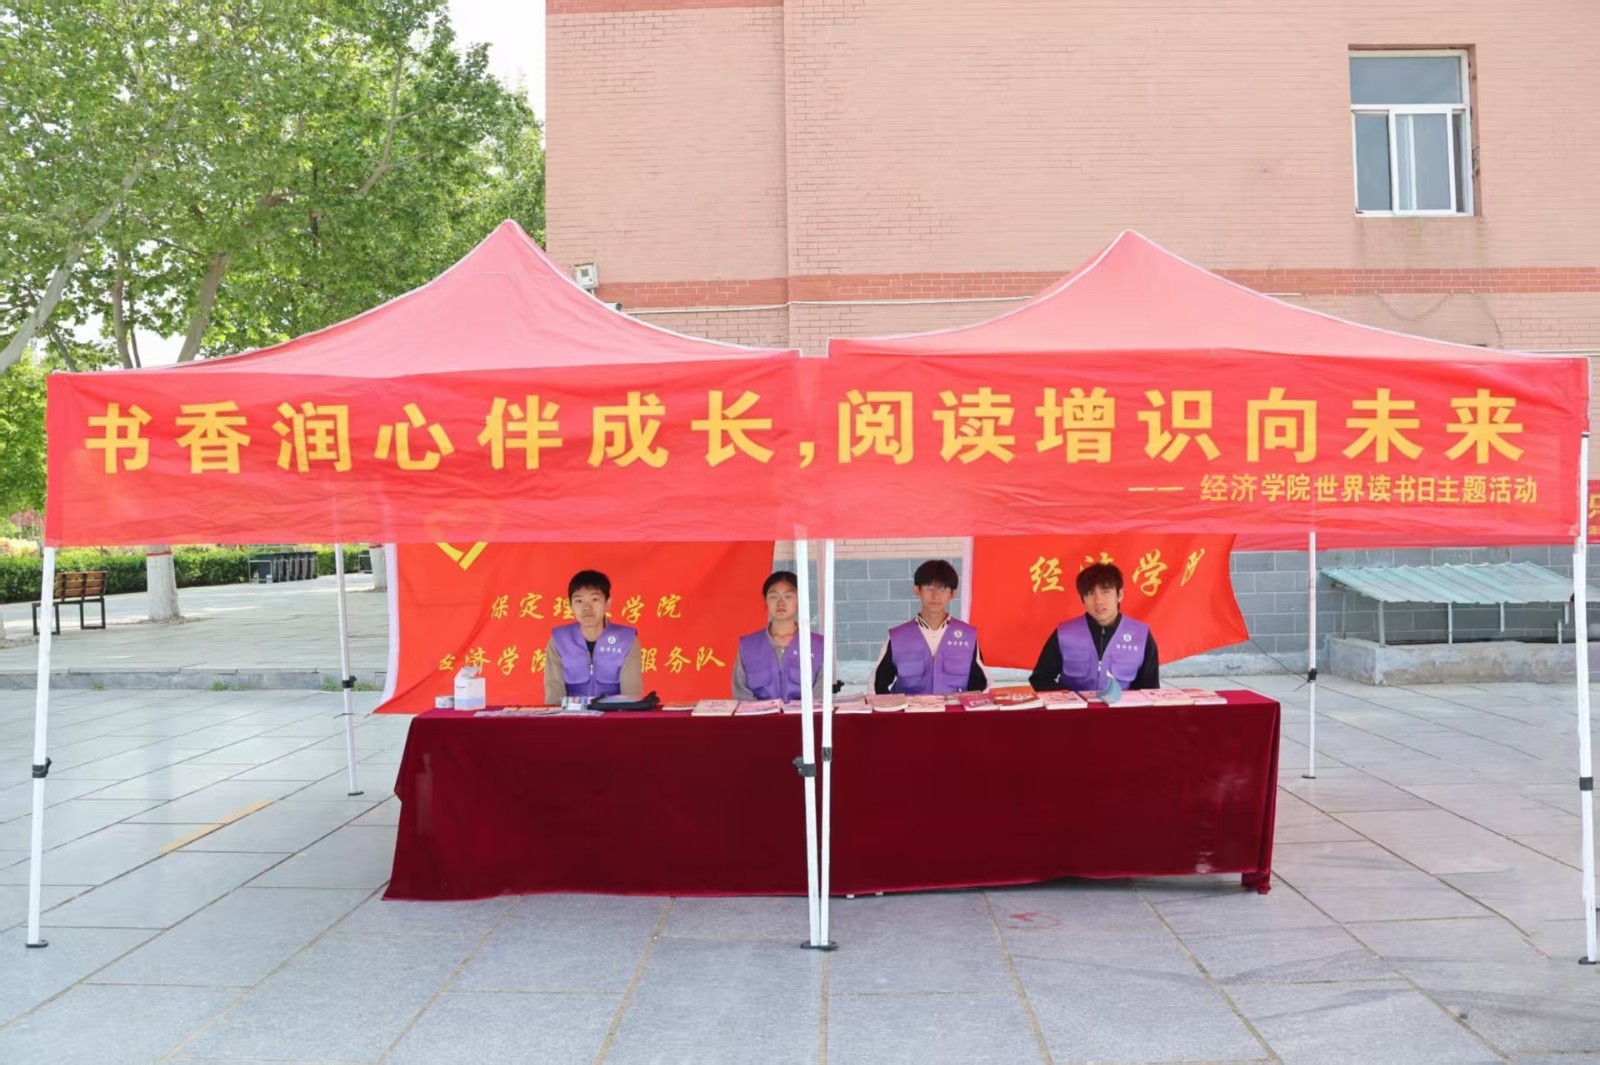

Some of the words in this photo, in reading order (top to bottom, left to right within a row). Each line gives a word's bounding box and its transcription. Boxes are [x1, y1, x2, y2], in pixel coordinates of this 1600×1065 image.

[491, 592, 682, 624] 保定理学院
